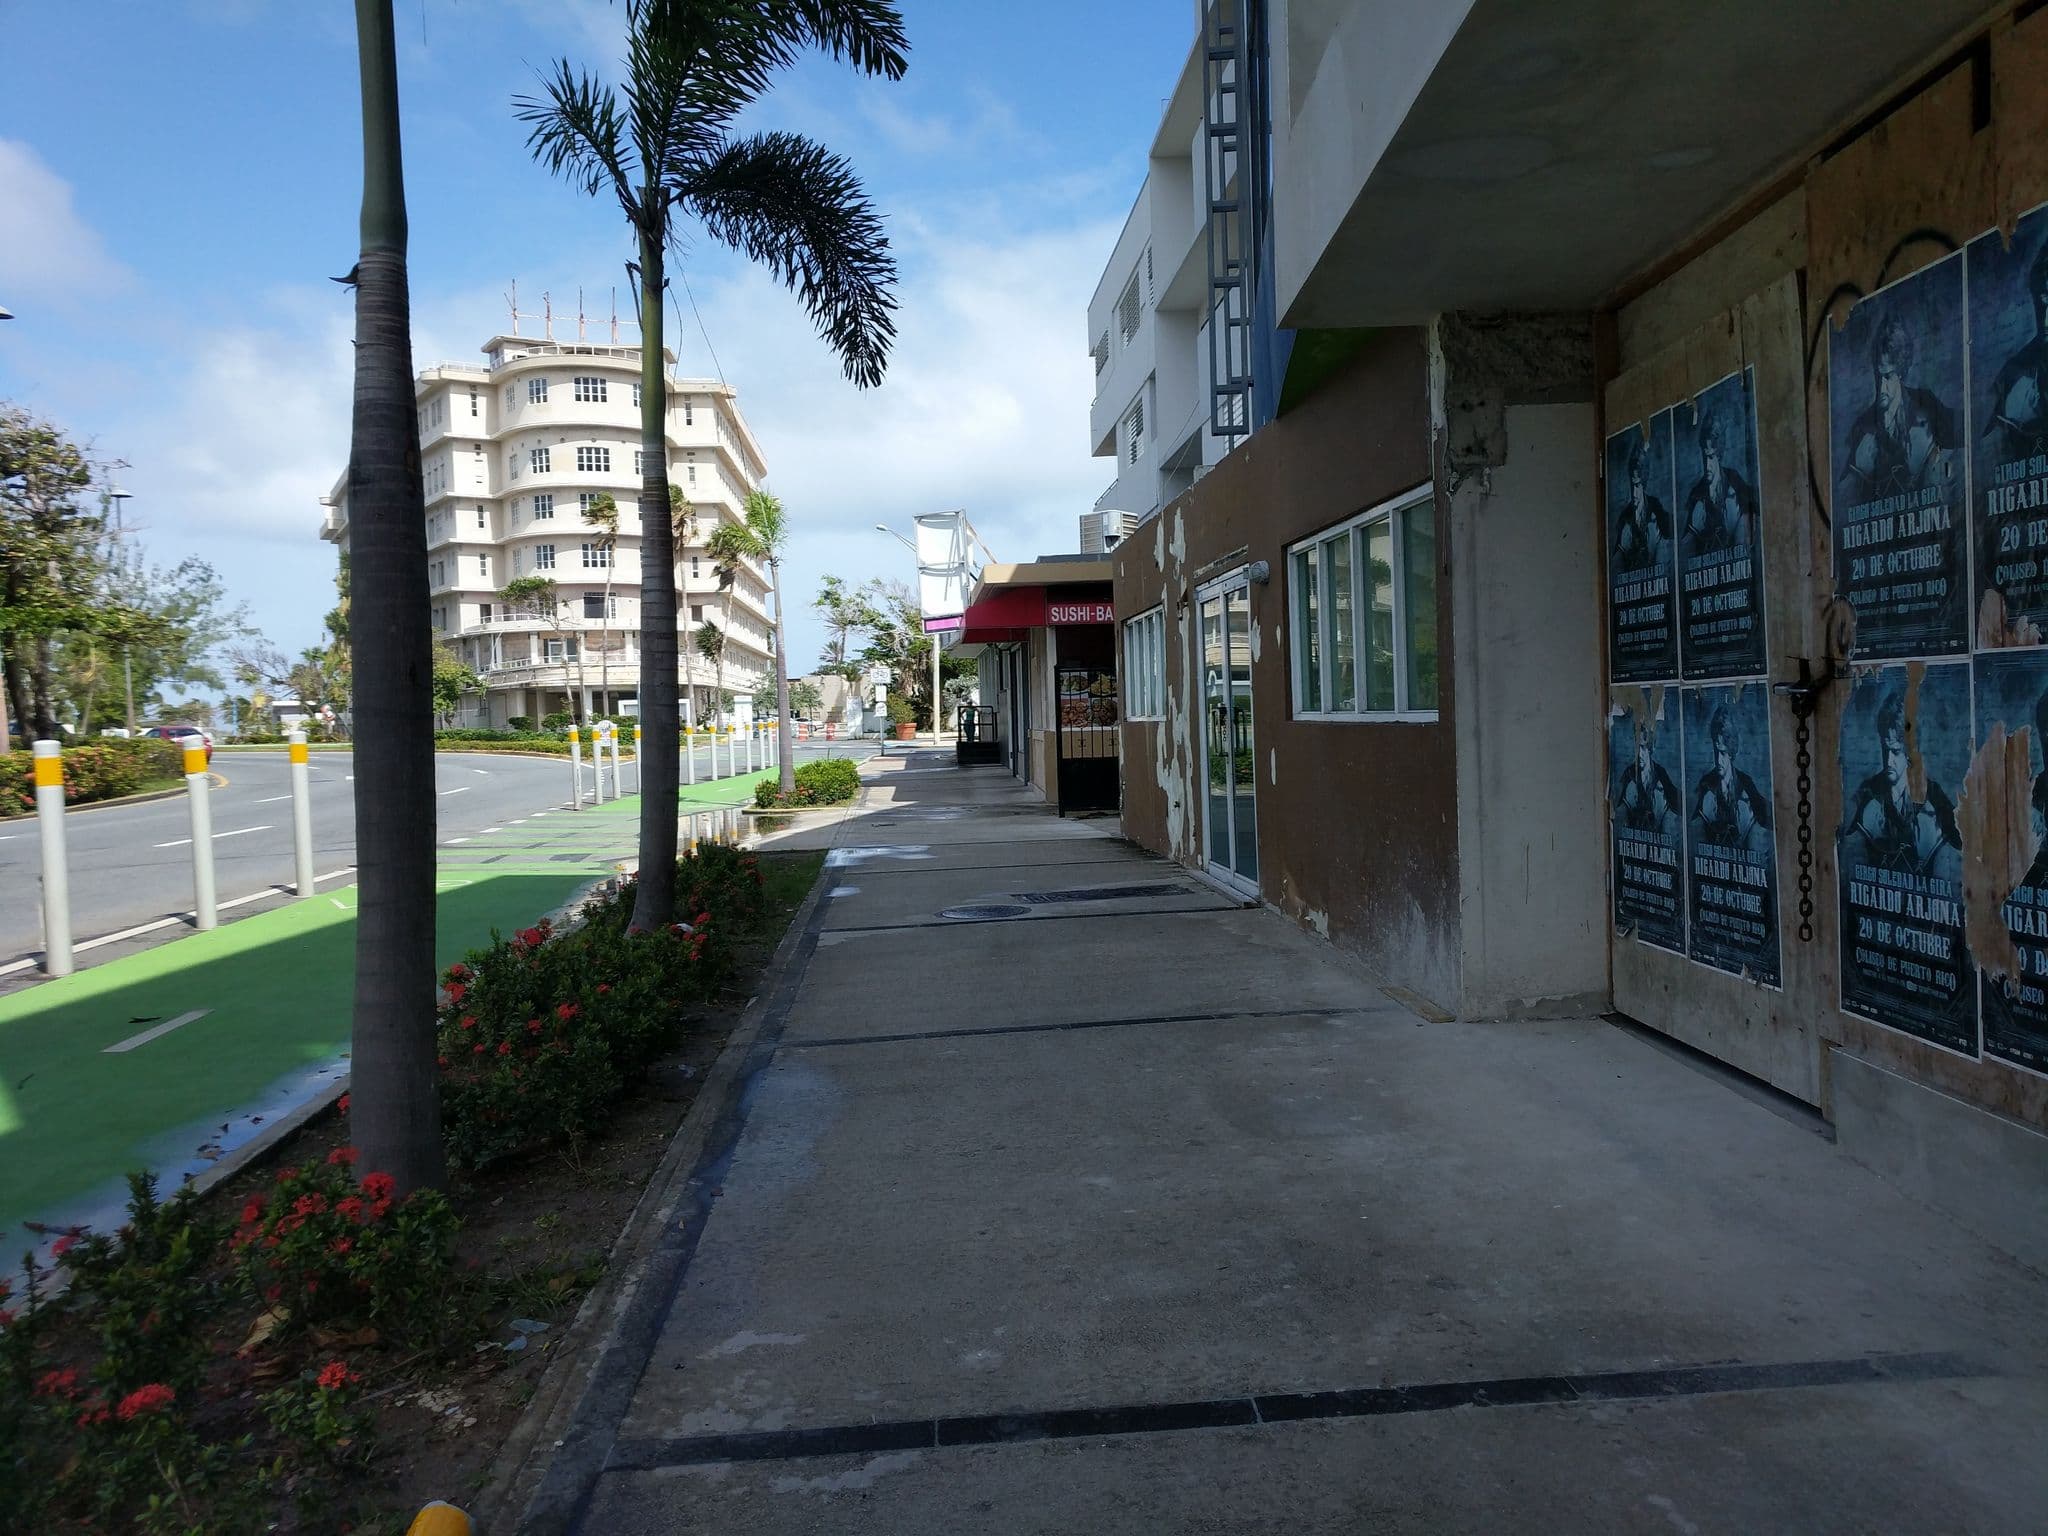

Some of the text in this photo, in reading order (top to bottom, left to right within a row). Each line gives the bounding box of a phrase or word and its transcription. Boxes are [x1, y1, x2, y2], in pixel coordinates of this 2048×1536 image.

[1843, 504, 1952, 550] RICARDO ARJONA
[2000, 524, 2020, 553] 20
[1852, 544, 1941, 580] 20 DE OCTUBRE
[1994, 560, 2038, 585] COLISEO
[1685, 566, 1718, 591] RICARDO
[1926, 577, 1947, 597] RICO
[1051, 606, 1114, 621] SUSHI-BA
[1691, 589, 1748, 617] 20 DE OCTUBRE
[1695, 857, 1768, 888] RICARDO ARJONA
[1878, 868, 1914, 890] SOLEDAD
[1916, 874, 1928, 893] LA
[1930, 877, 1952, 898] GIRA
[1701, 884, 1762, 914] 20 DE OCTUBRE
[1849, 881, 1960, 928] RICARDO ARJONA
[1858, 916, 1951, 960] 20 DE OCTUBRE
[1856, 946, 1885, 968] COLISEO
[1888, 955, 1898, 972] DE
[1900, 959, 1932, 982] PUERTO
[1935, 968, 1957, 992] RICO
